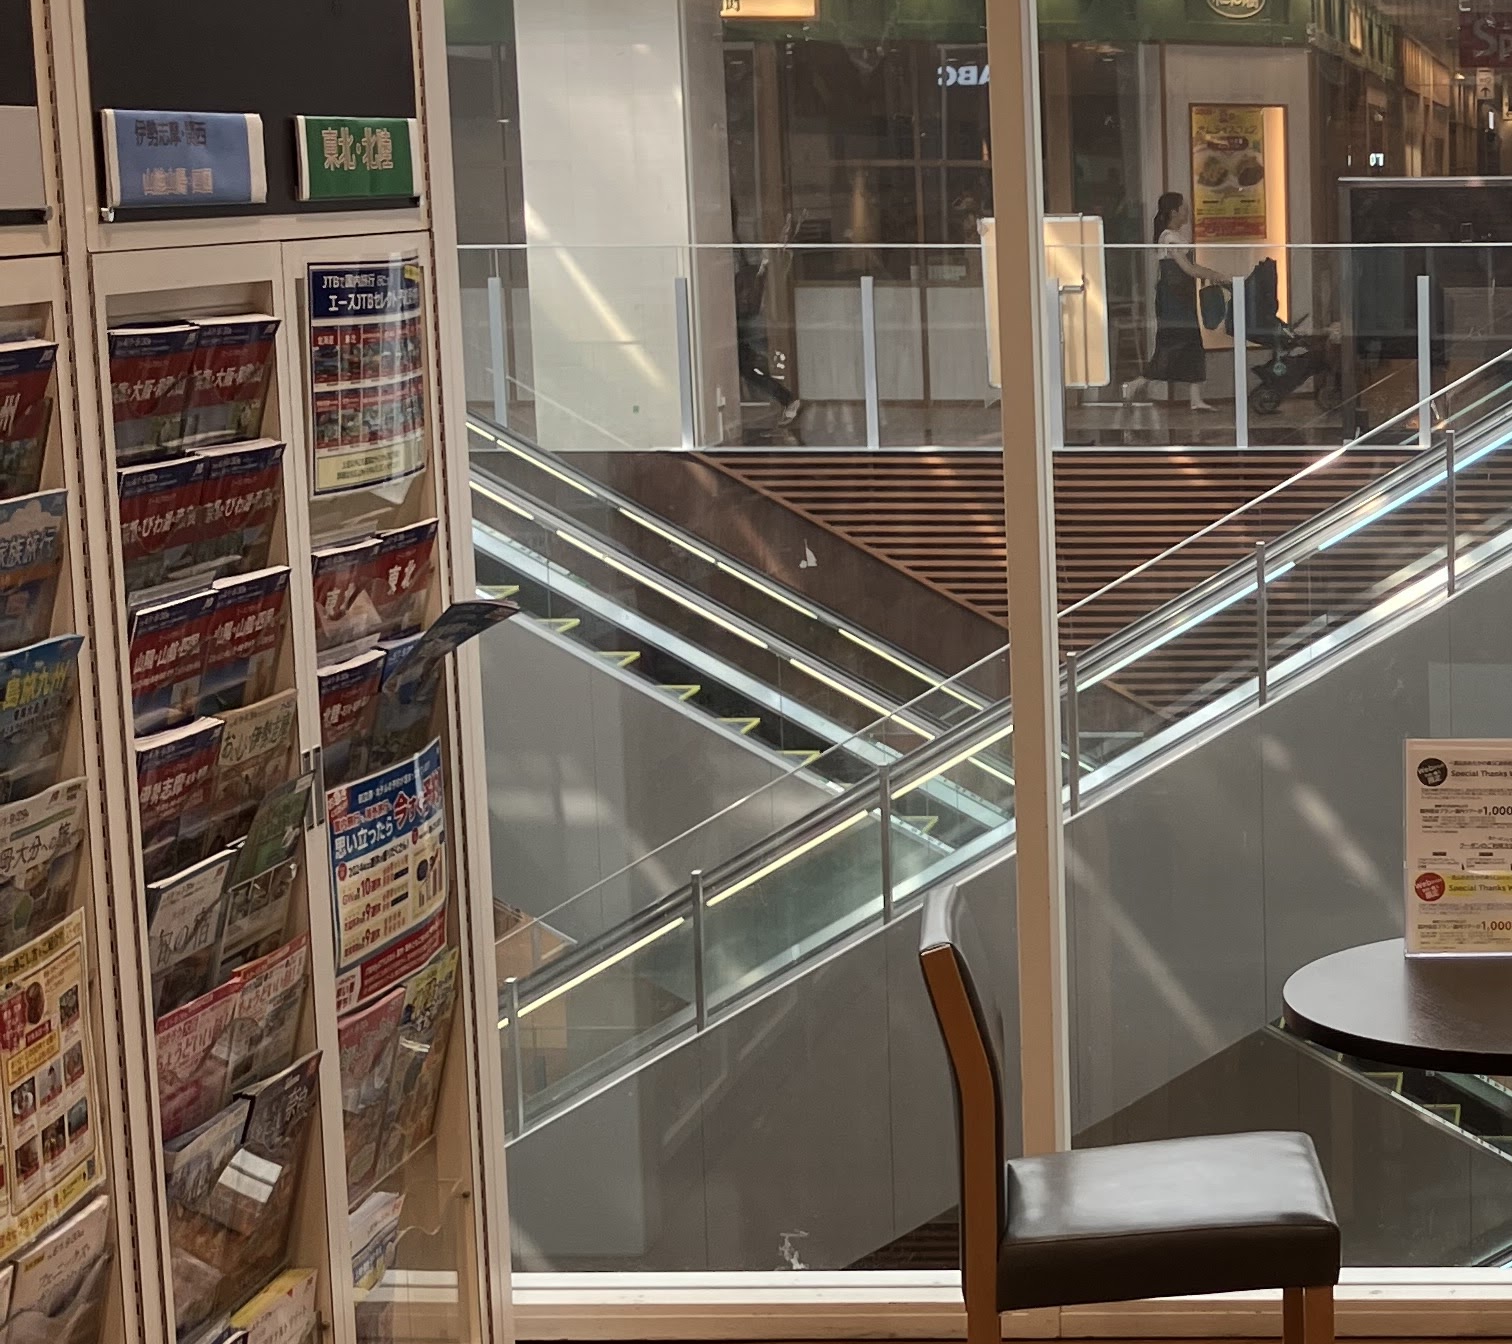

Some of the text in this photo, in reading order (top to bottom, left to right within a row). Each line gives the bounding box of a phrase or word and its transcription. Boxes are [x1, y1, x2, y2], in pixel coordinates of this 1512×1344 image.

[321, 127, 394, 172] 東北・北陸
[1450, 769, 1479, 778] Special
[1481, 769, 1508, 778] Thanks
[334, 815, 394, 860] 思い立ったら
[1448, 884, 1477, 893] Special
[1478, 884, 1506, 893] Thanks
